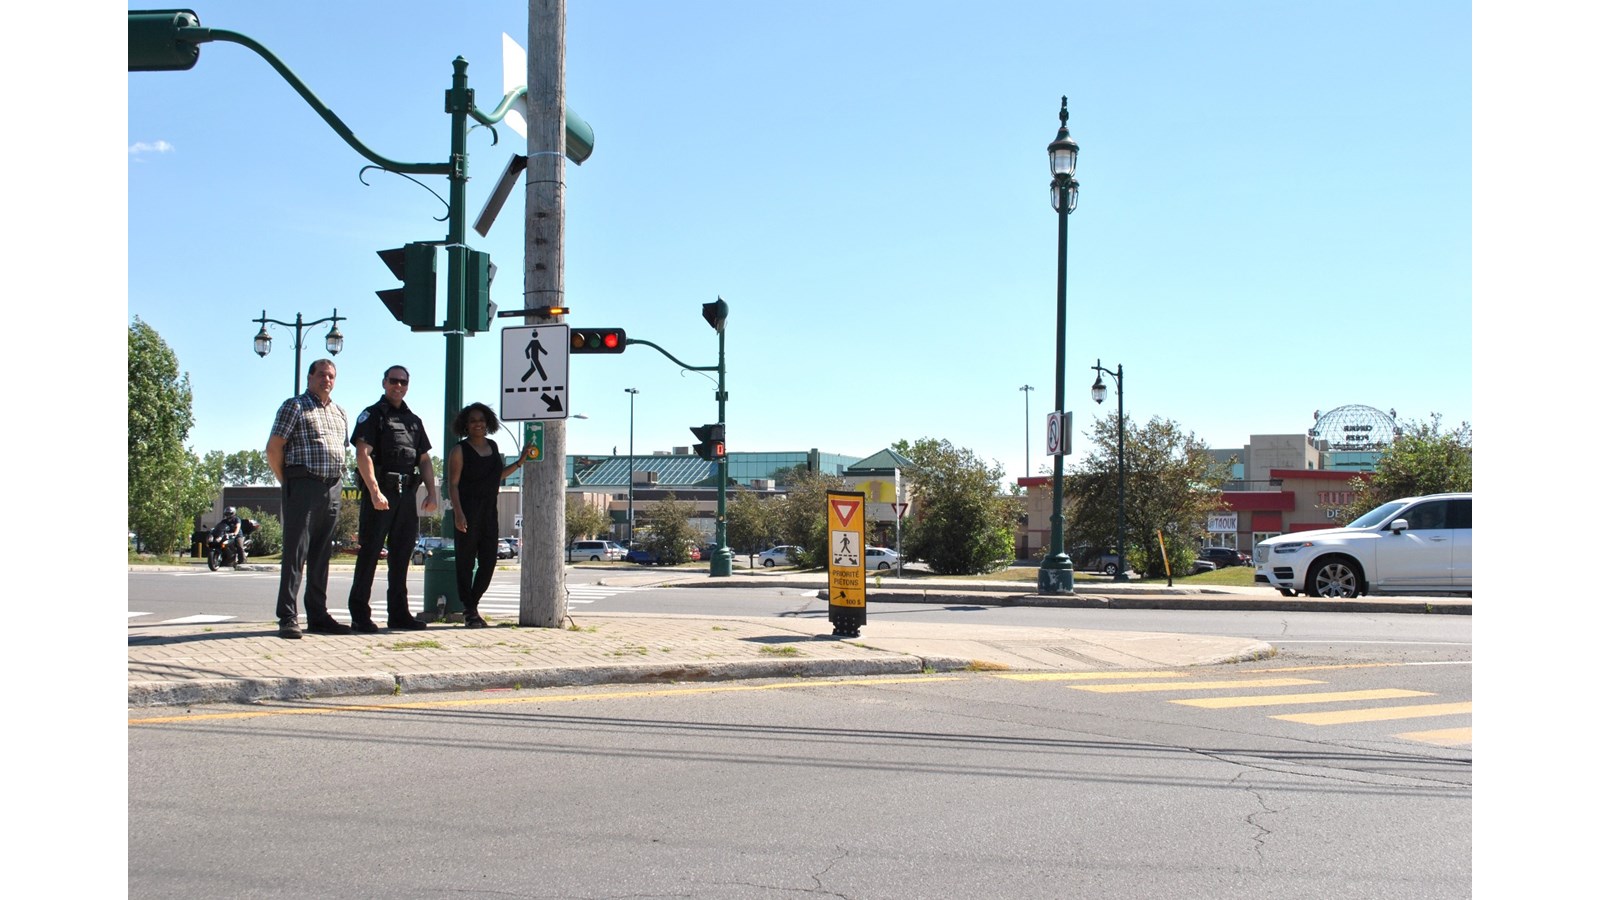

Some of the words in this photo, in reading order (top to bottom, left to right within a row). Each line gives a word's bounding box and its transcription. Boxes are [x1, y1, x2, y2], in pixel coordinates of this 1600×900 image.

[1215, 517, 1236, 529] TAOUK
[832, 570, 860, 578] PRIORITÉ
[834, 578, 859, 586] PIÉTONS
